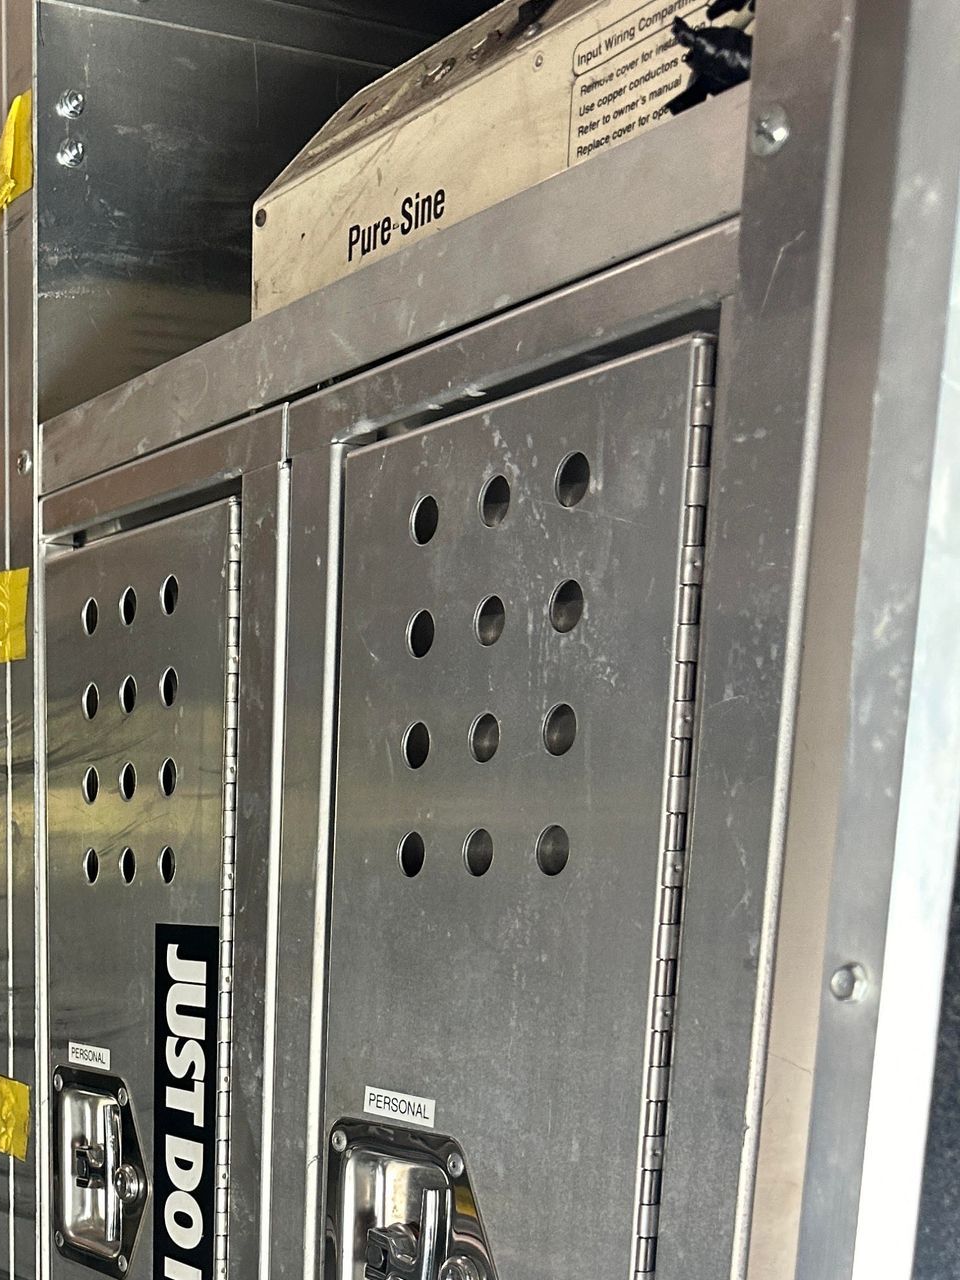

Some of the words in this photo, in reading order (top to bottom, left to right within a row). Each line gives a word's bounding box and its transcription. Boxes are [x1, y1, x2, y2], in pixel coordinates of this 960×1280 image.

[577, 43, 602, 67] Input
[604, 26, 635, 51] Wiring
[579, 101, 595, 117] Use
[597, 85, 627, 109] copper
[628, 57, 679, 91] conductors
[580, 72, 614, 97] Remove
[615, 57, 640, 78] cover
[640, 49, 653, 64] for
[577, 118, 600, 138] Refer
[602, 114, 611, 126] to
[612, 94, 646, 120] owner's
[648, 74, 682, 100] manual
[576, 135, 611, 159] Replace
[612, 121, 636, 140] cover
[638, 113, 651, 127] for
[71, 1046, 106, 1065] PERSONAL
[165, 943, 208, 1128] JUST
[368, 1092, 430, 1120] PERSONAL
[163, 1140, 205, 1250] DO
